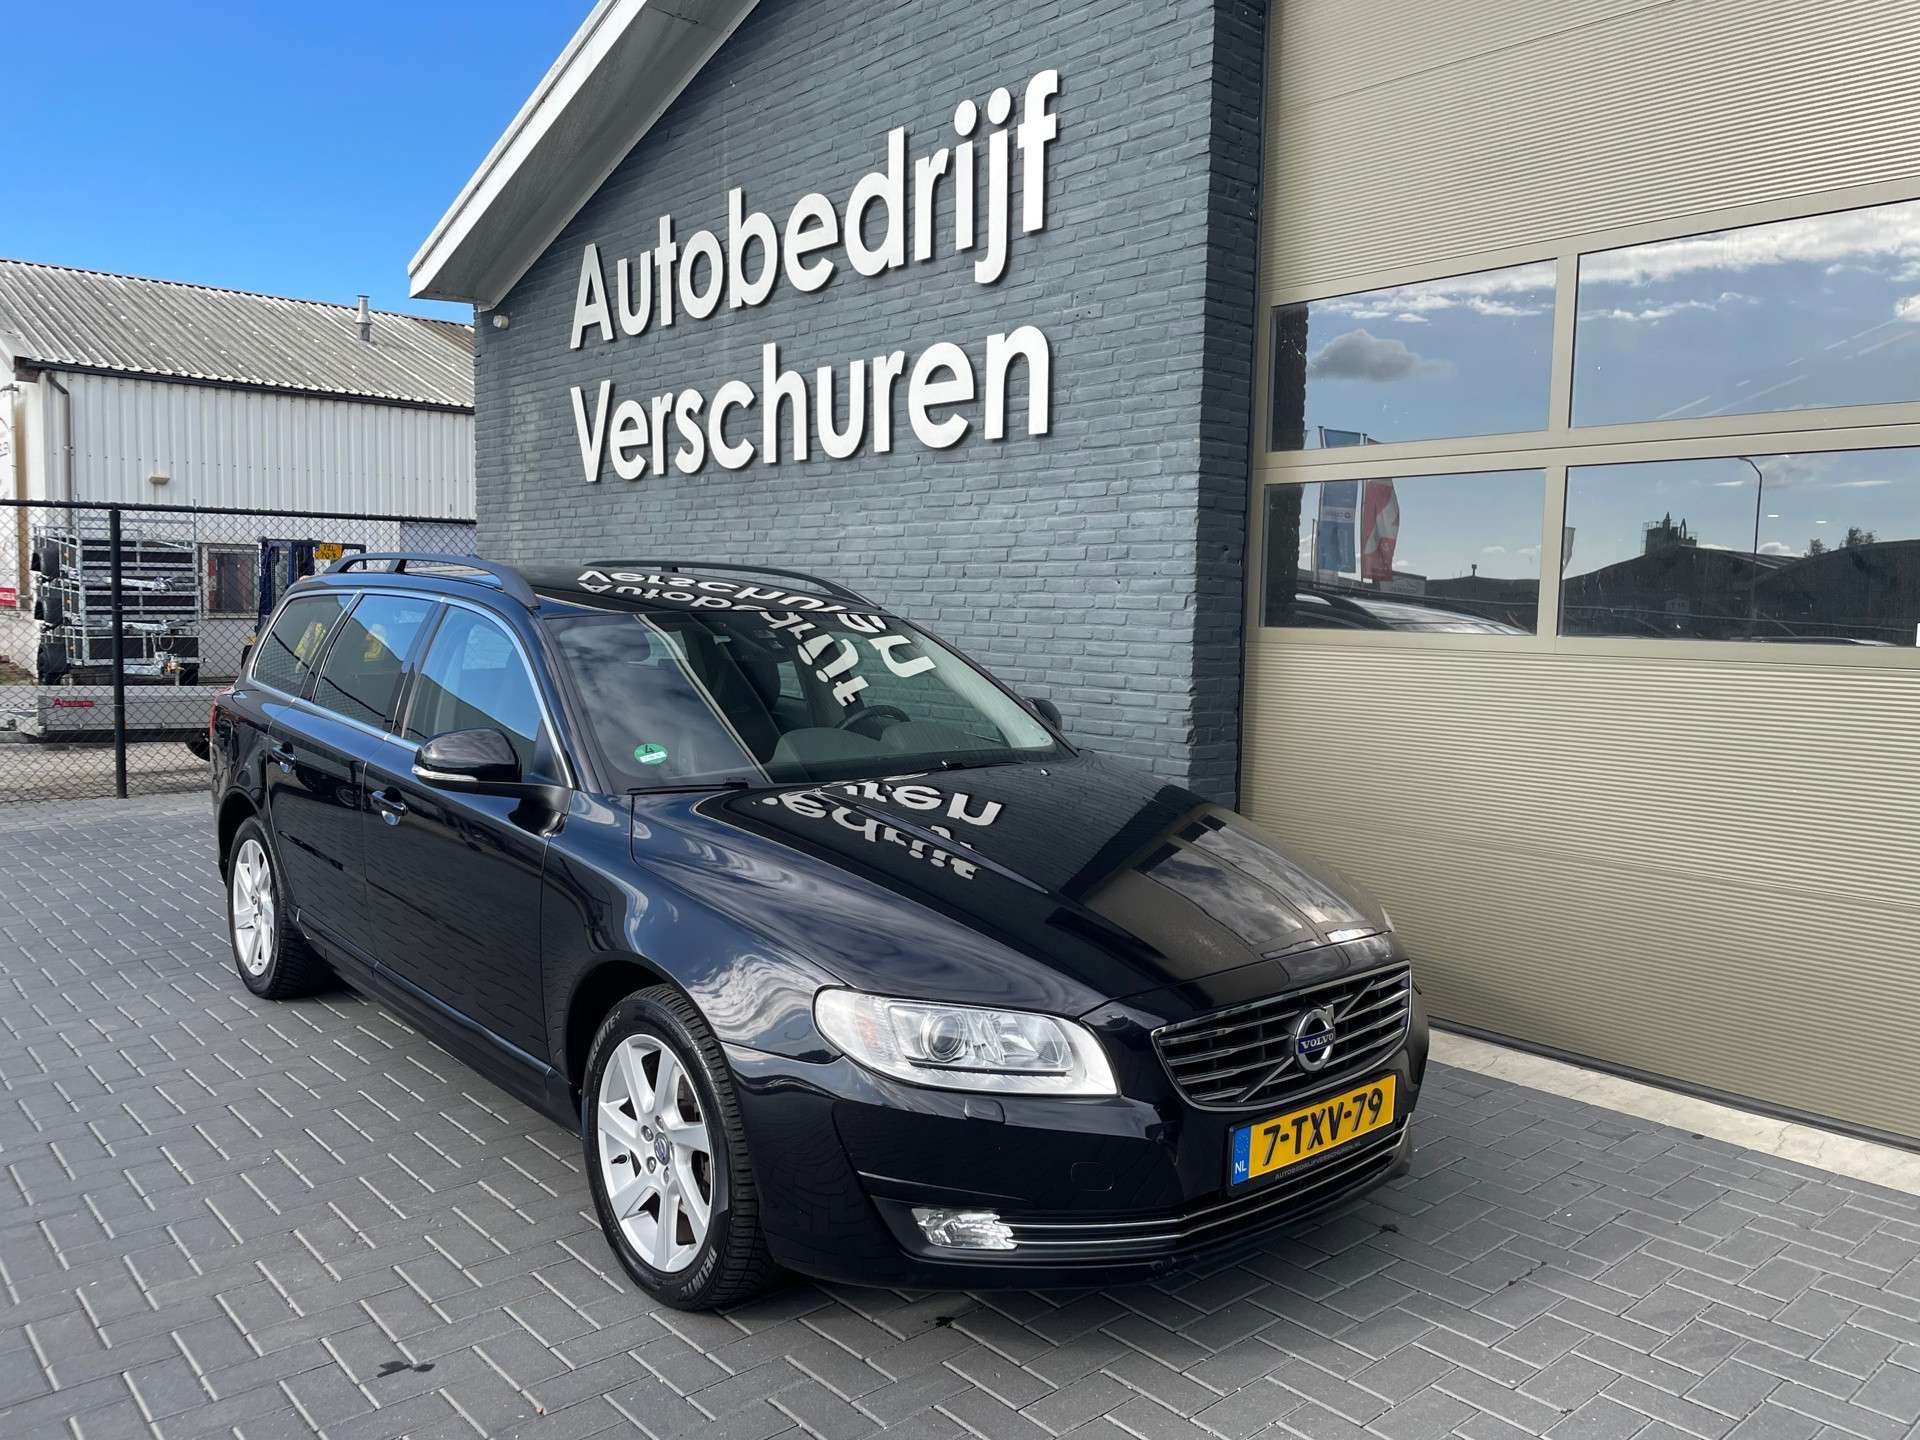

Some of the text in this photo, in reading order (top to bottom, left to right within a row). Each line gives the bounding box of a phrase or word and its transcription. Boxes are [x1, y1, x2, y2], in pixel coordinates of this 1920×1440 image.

[569, 69, 1058, 349] Autobedrijf
[570, 324, 1050, 482] Verschuren
[1300, 1032, 1334, 1049] VOLVO
[1234, 1159, 1248, 1175] NL
[1262, 1087, 1384, 1167] 7-TXV-79
